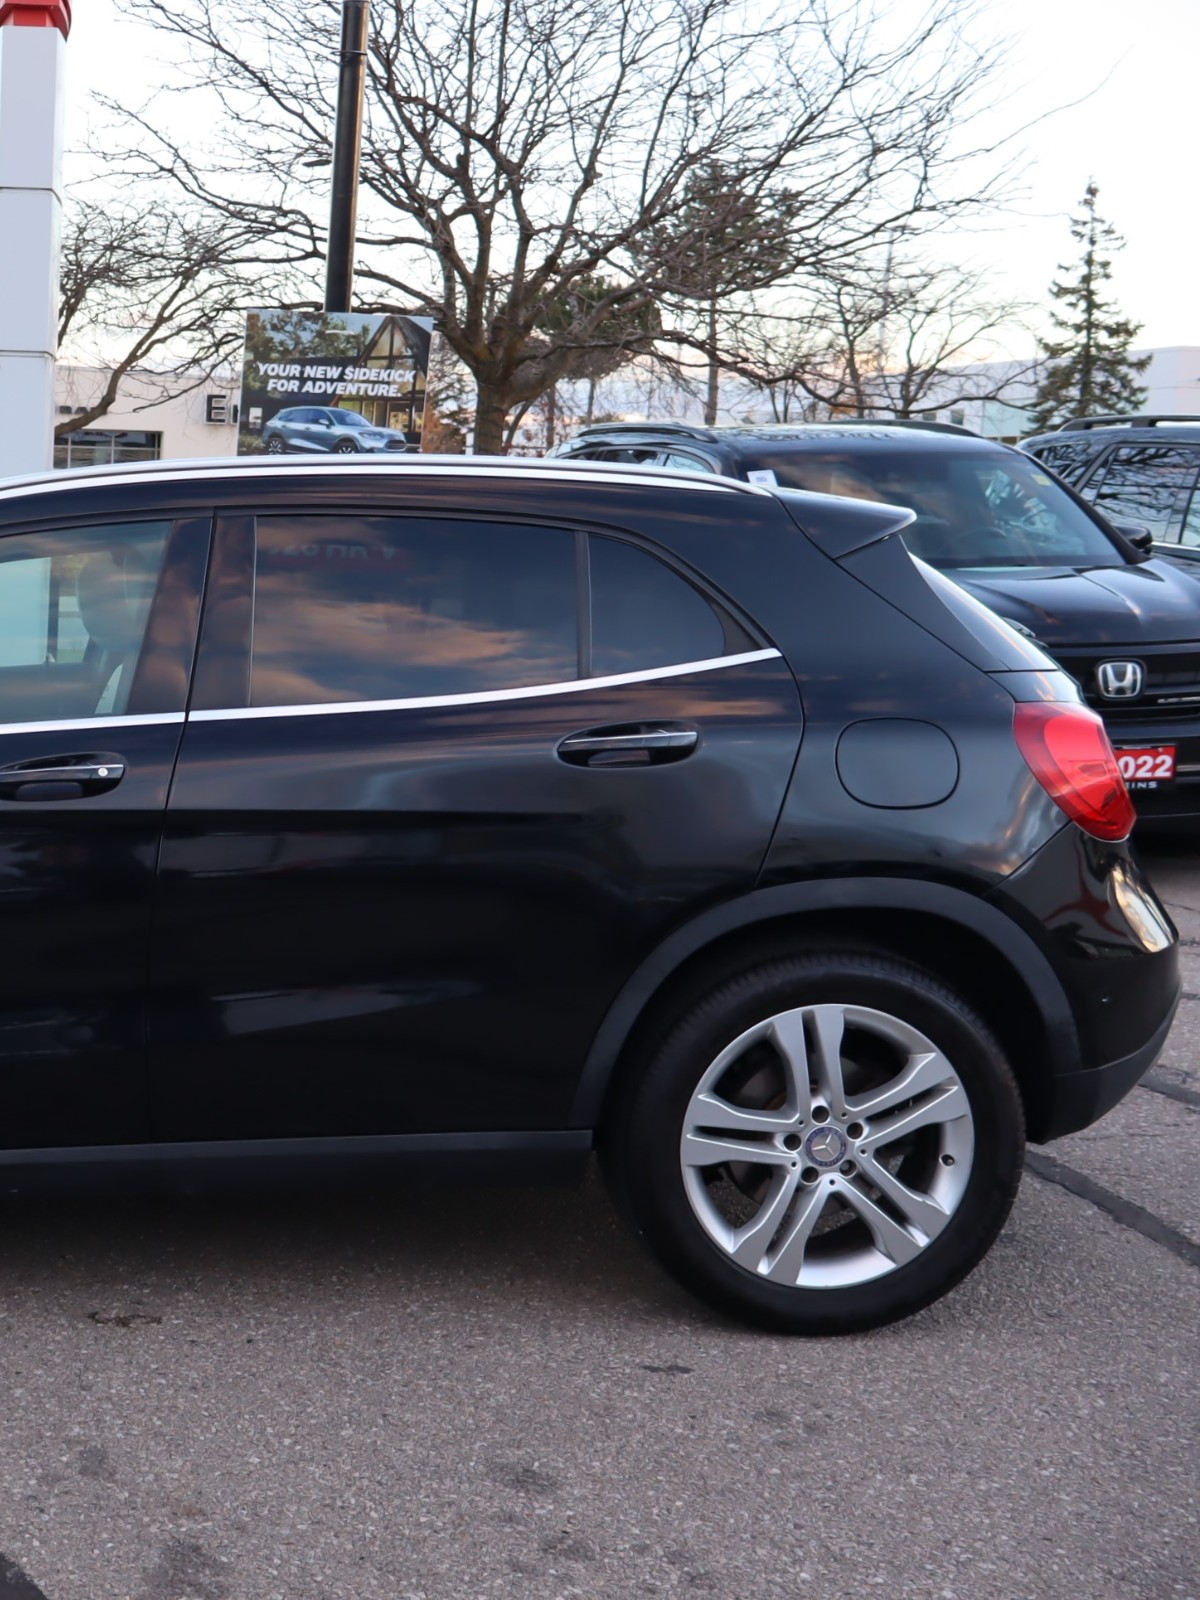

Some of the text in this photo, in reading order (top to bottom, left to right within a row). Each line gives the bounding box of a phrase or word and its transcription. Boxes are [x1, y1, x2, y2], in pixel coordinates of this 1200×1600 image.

[256, 363, 416, 383] YOUR NEW SIDEKICK
[267, 379, 403, 397] FOR ADVENTURE.
[1117, 754, 1173, 779] 022
